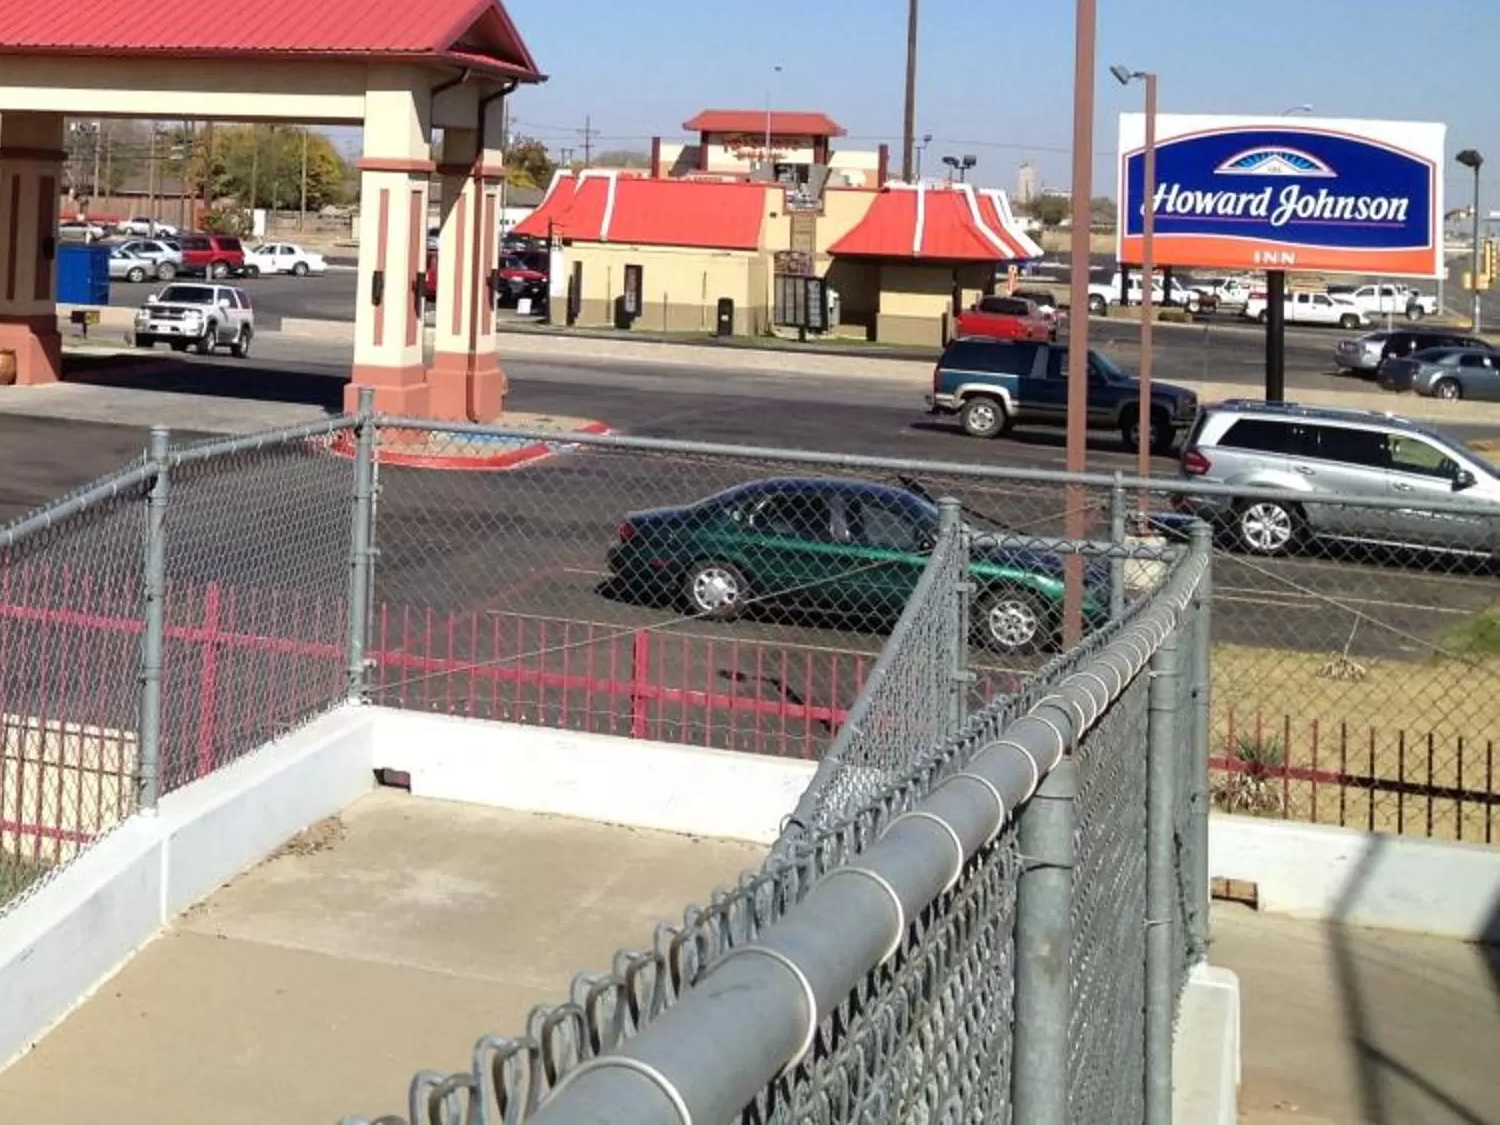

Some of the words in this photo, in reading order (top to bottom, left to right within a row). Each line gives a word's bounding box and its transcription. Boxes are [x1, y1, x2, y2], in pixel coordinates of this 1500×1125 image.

[1140, 183, 1272, 217] Howard
[1270, 184, 1409, 226] Johnson
[1253, 250, 1296, 265] INN
